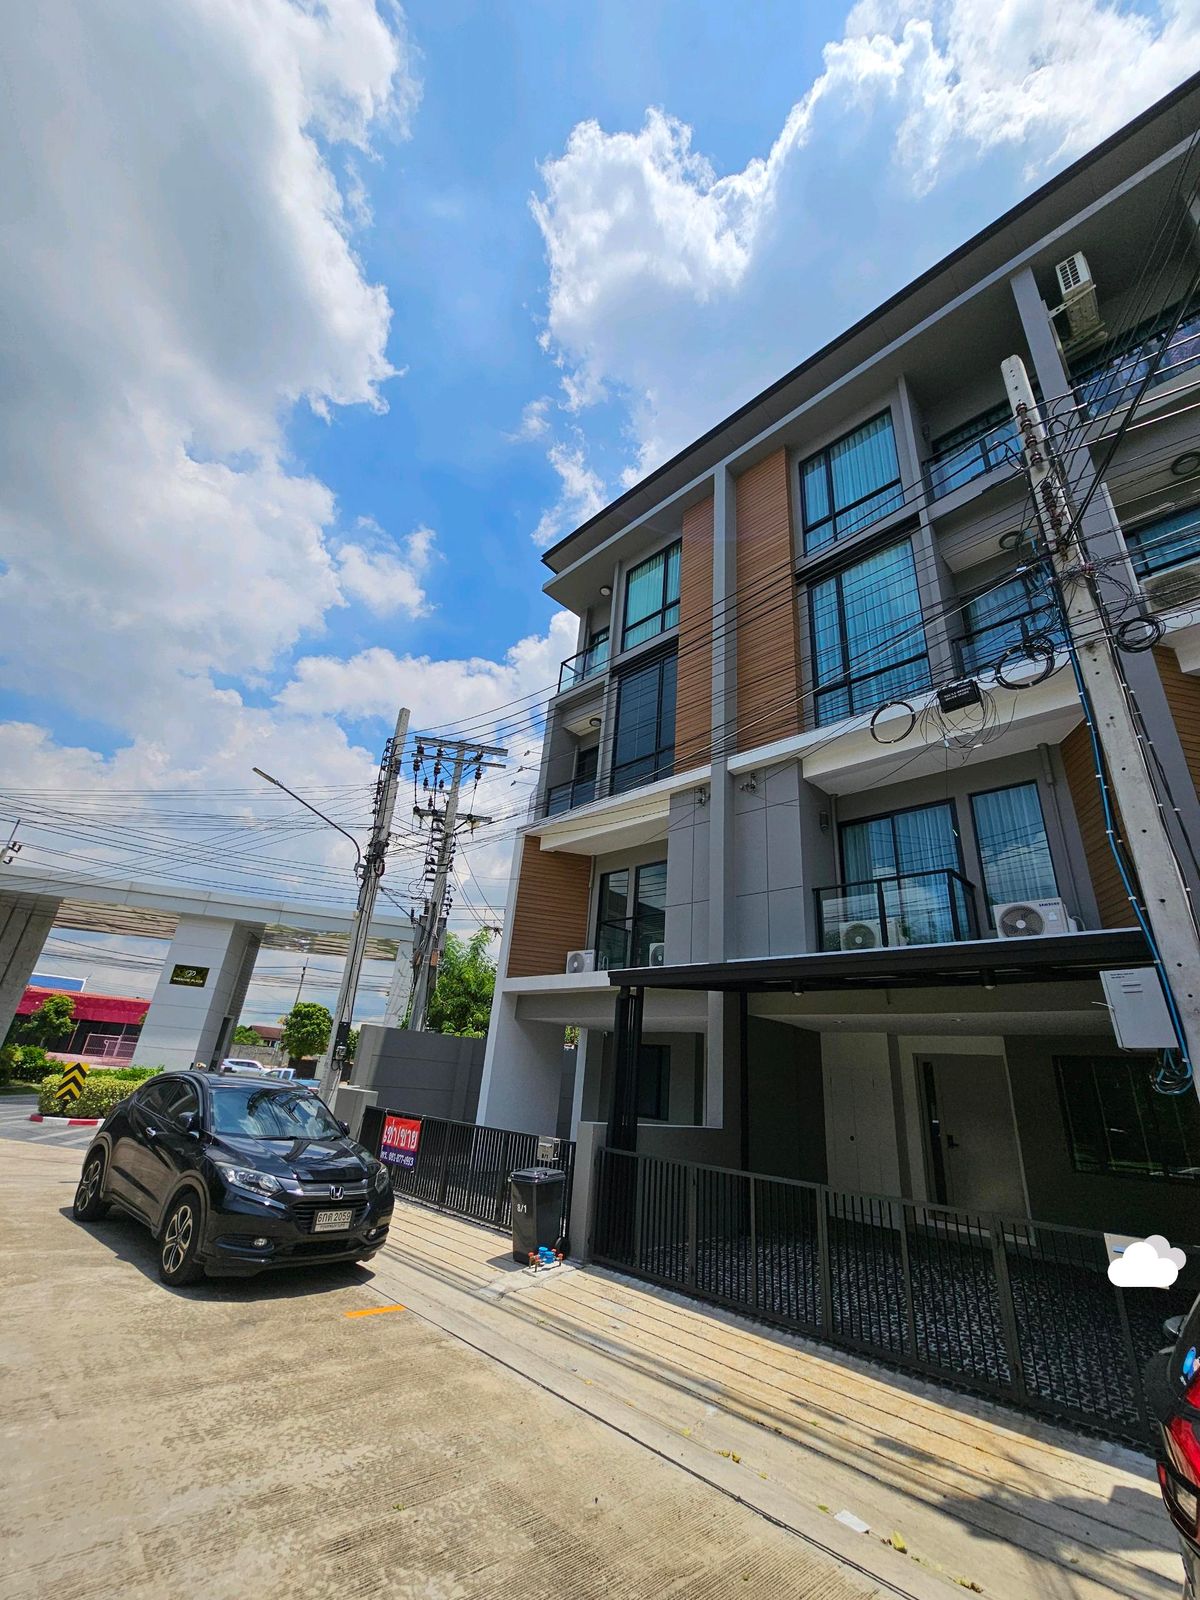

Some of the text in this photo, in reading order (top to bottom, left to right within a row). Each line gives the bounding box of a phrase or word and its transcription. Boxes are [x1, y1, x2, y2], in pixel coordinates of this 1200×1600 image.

[382, 1119, 418, 1149] เช่า/ขาย
[333, 1211, 351, 1221] 2059
